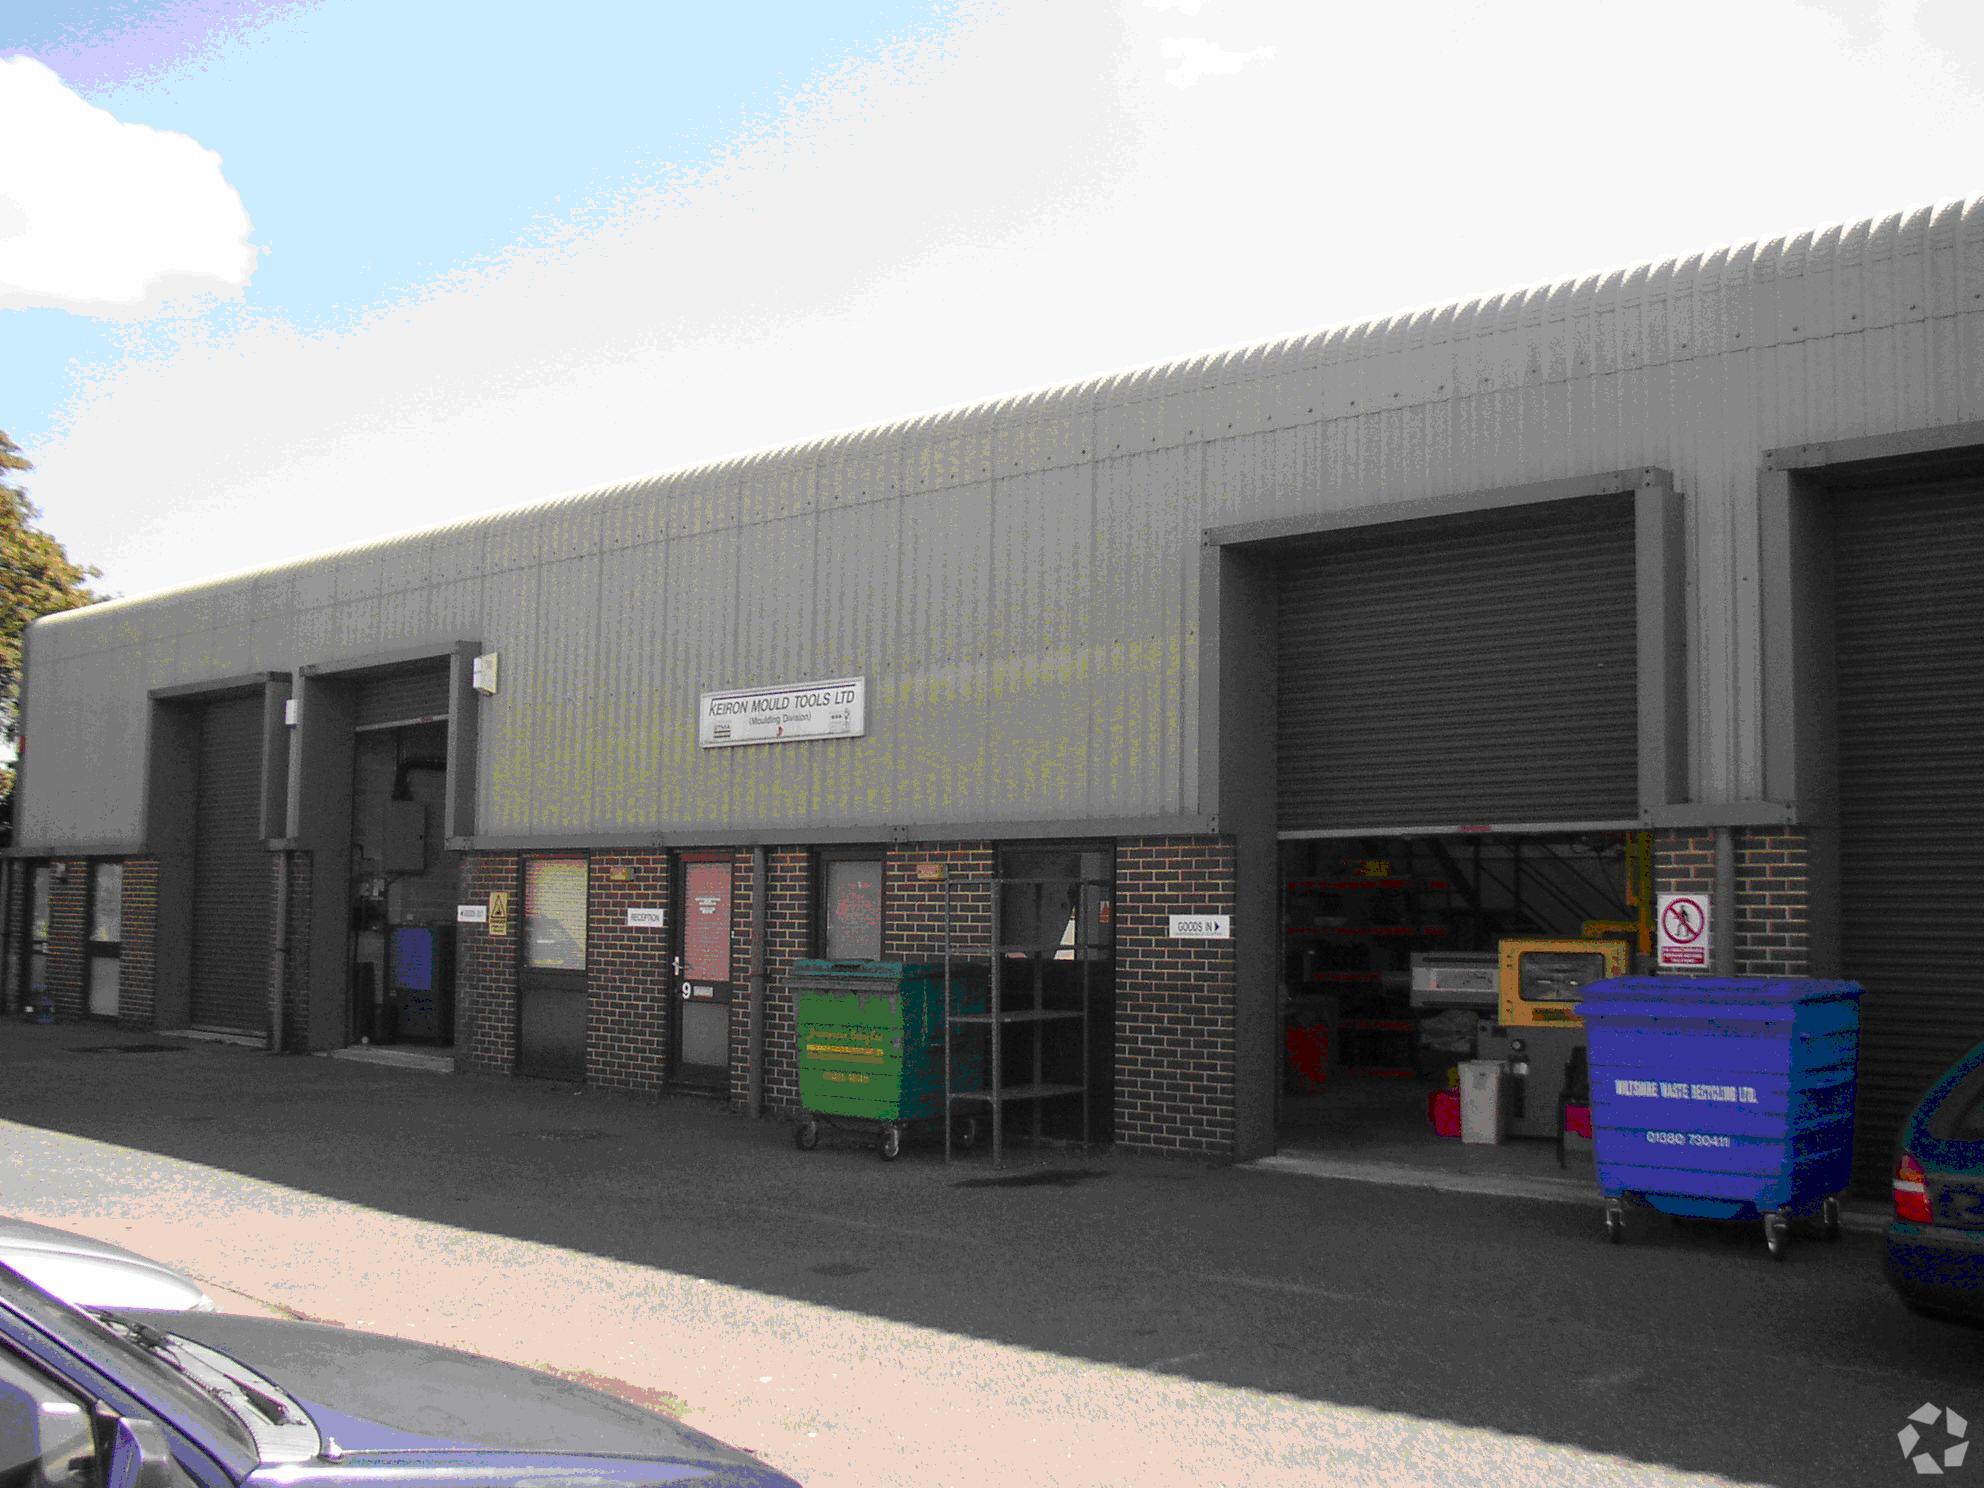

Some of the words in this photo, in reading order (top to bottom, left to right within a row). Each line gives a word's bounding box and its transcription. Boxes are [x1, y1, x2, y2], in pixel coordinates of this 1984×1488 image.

[709, 699, 748, 716] KEIRON
[751, 697, 790, 712] MOULD
[794, 693, 831, 709] TOOLS
[835, 690, 855, 705] LTD
[1177, 921, 1203, 932] GOODS
[1205, 921, 1213, 932] IN
[682, 982, 692, 999] 9
[1615, 1079, 1659, 1098] WILTSHIRE
[1660, 1081, 1690, 1099] WASTE
[1691, 1084, 1738, 1102] RECYCLING
